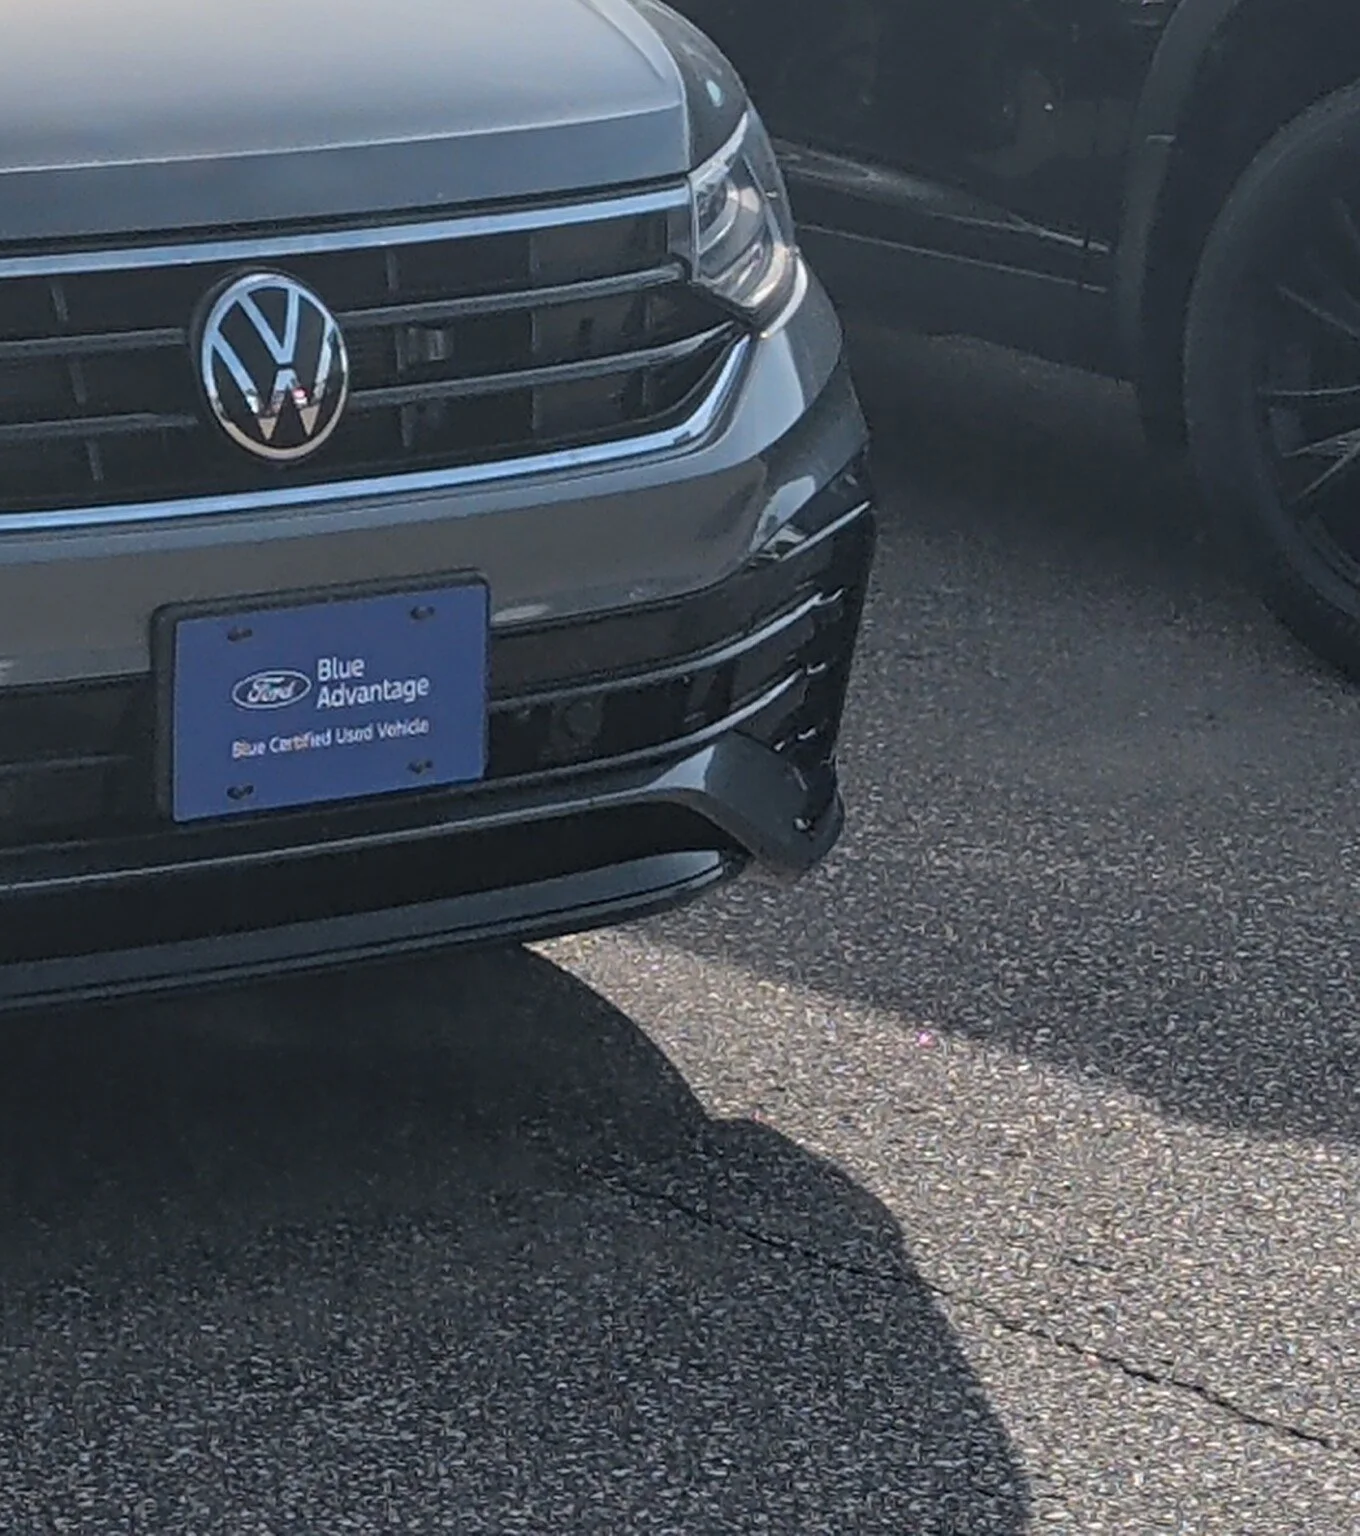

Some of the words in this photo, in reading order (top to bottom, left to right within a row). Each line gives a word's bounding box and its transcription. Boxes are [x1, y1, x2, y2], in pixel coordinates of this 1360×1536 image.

[316, 656, 365, 682] Blue
[247, 676, 296, 703] Ford
[316, 677, 430, 709] Advantage
[232, 740, 266, 759] Blue
[269, 728, 331, 754] Certified
[335, 722, 373, 745] Used
[377, 717, 430, 739] Vehicle
